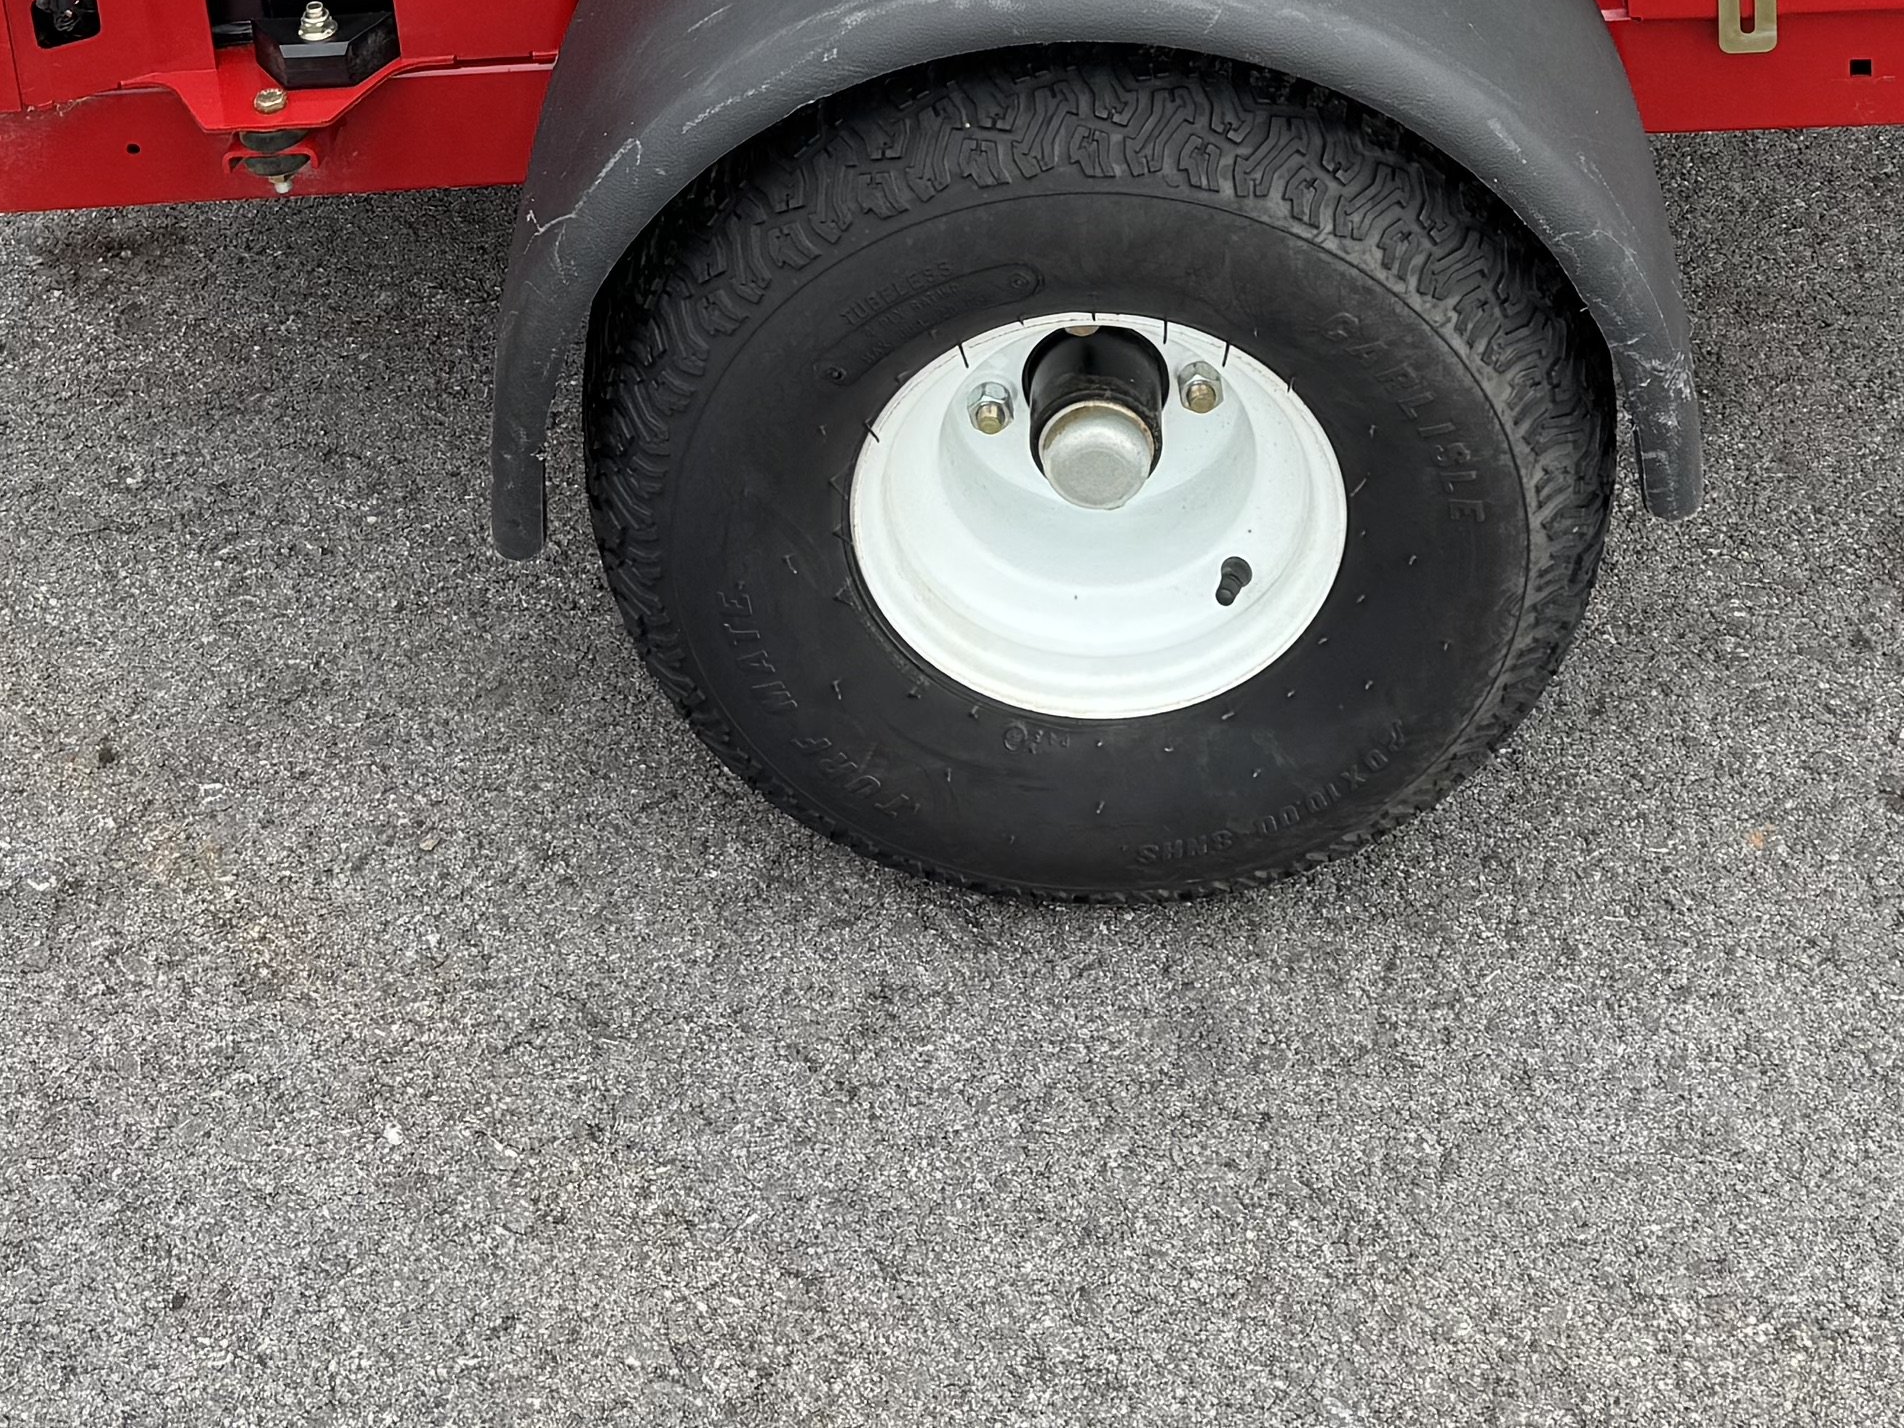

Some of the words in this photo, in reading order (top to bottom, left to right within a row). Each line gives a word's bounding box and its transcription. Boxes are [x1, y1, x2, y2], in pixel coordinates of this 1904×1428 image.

[840, 261, 952, 324] TUBELESS
[1327, 310, 1487, 524] CARLISLE
[717, 591, 800, 711] MATE
[790, 736, 911, 819] TURF
